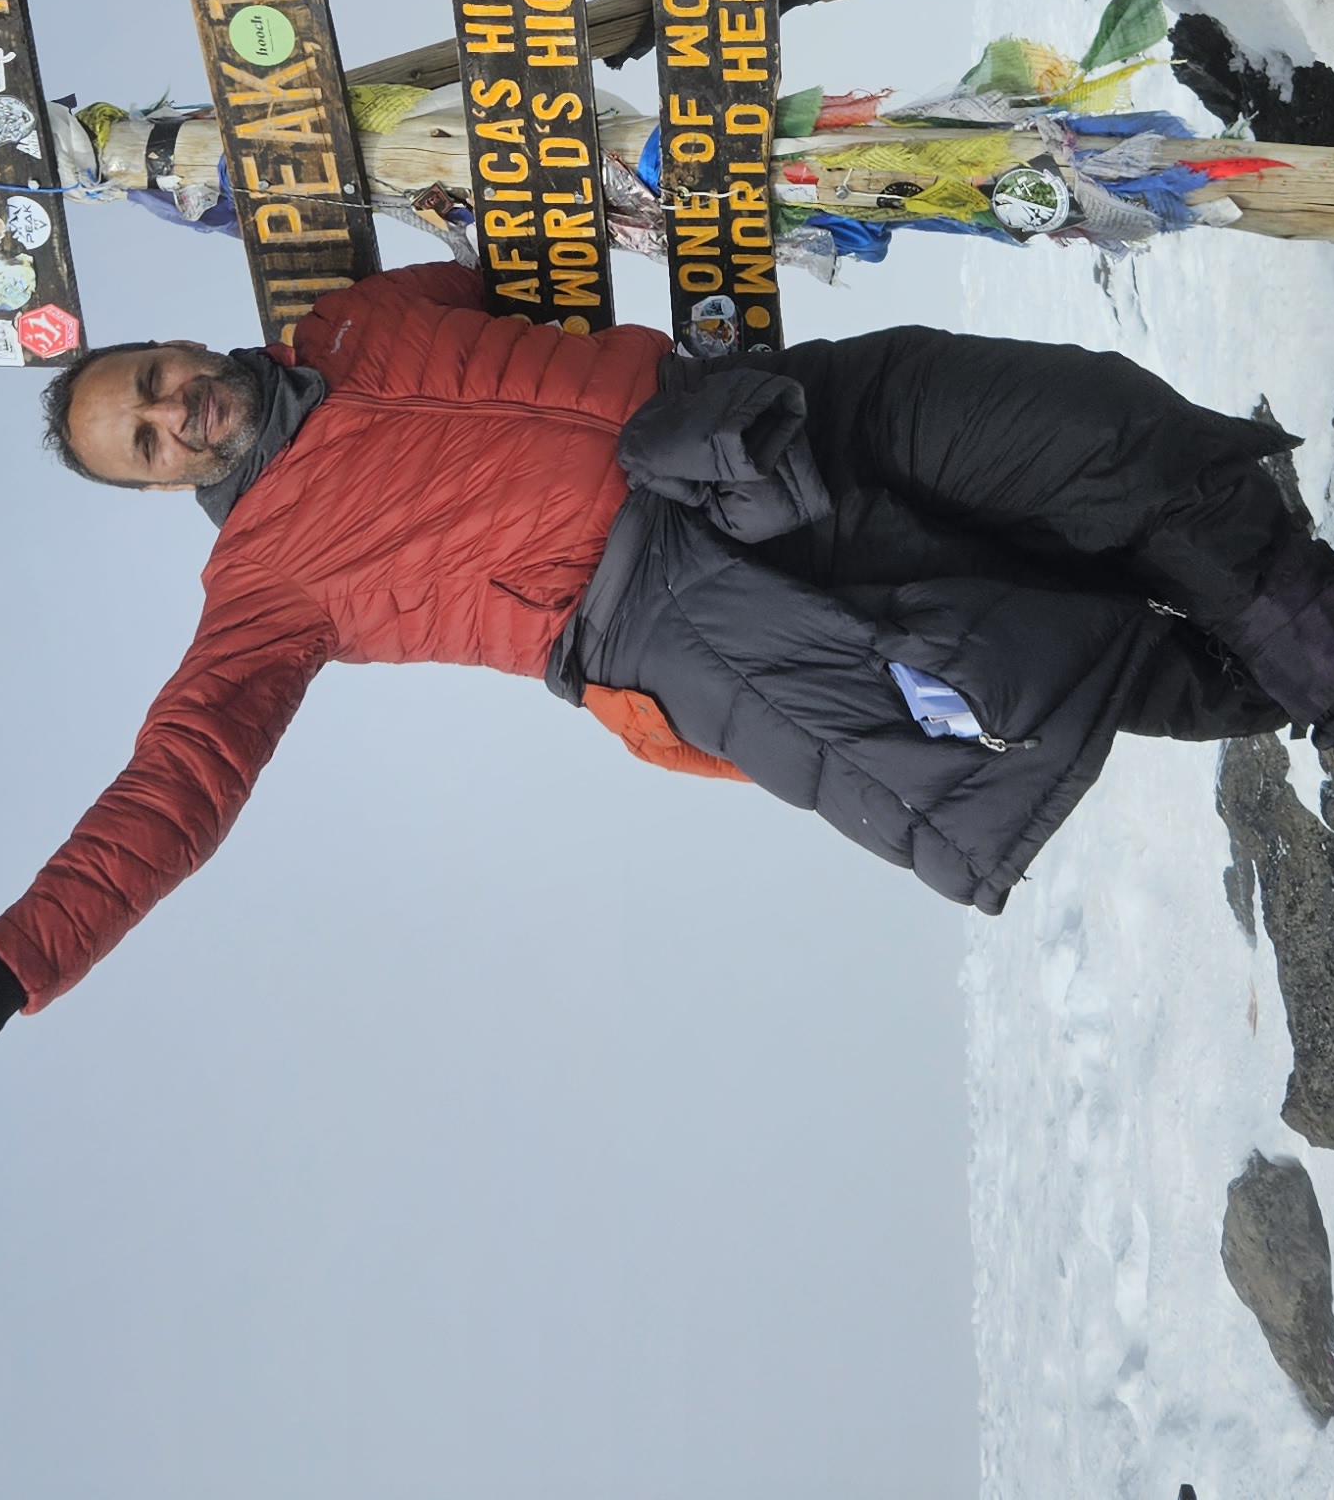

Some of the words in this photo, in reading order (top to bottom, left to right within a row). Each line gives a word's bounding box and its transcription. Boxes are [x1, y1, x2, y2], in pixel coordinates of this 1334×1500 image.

[250, 15, 268, 56] hooch
[220, 41, 351, 243] PEAK,
[670, 93, 715, 163] OF
[22, 204, 35, 243] PEAK
[471, 78, 541, 303] AFRICA'S
[532, 93, 601, 305] WORLD'S
[675, 191, 724, 292] ONE
